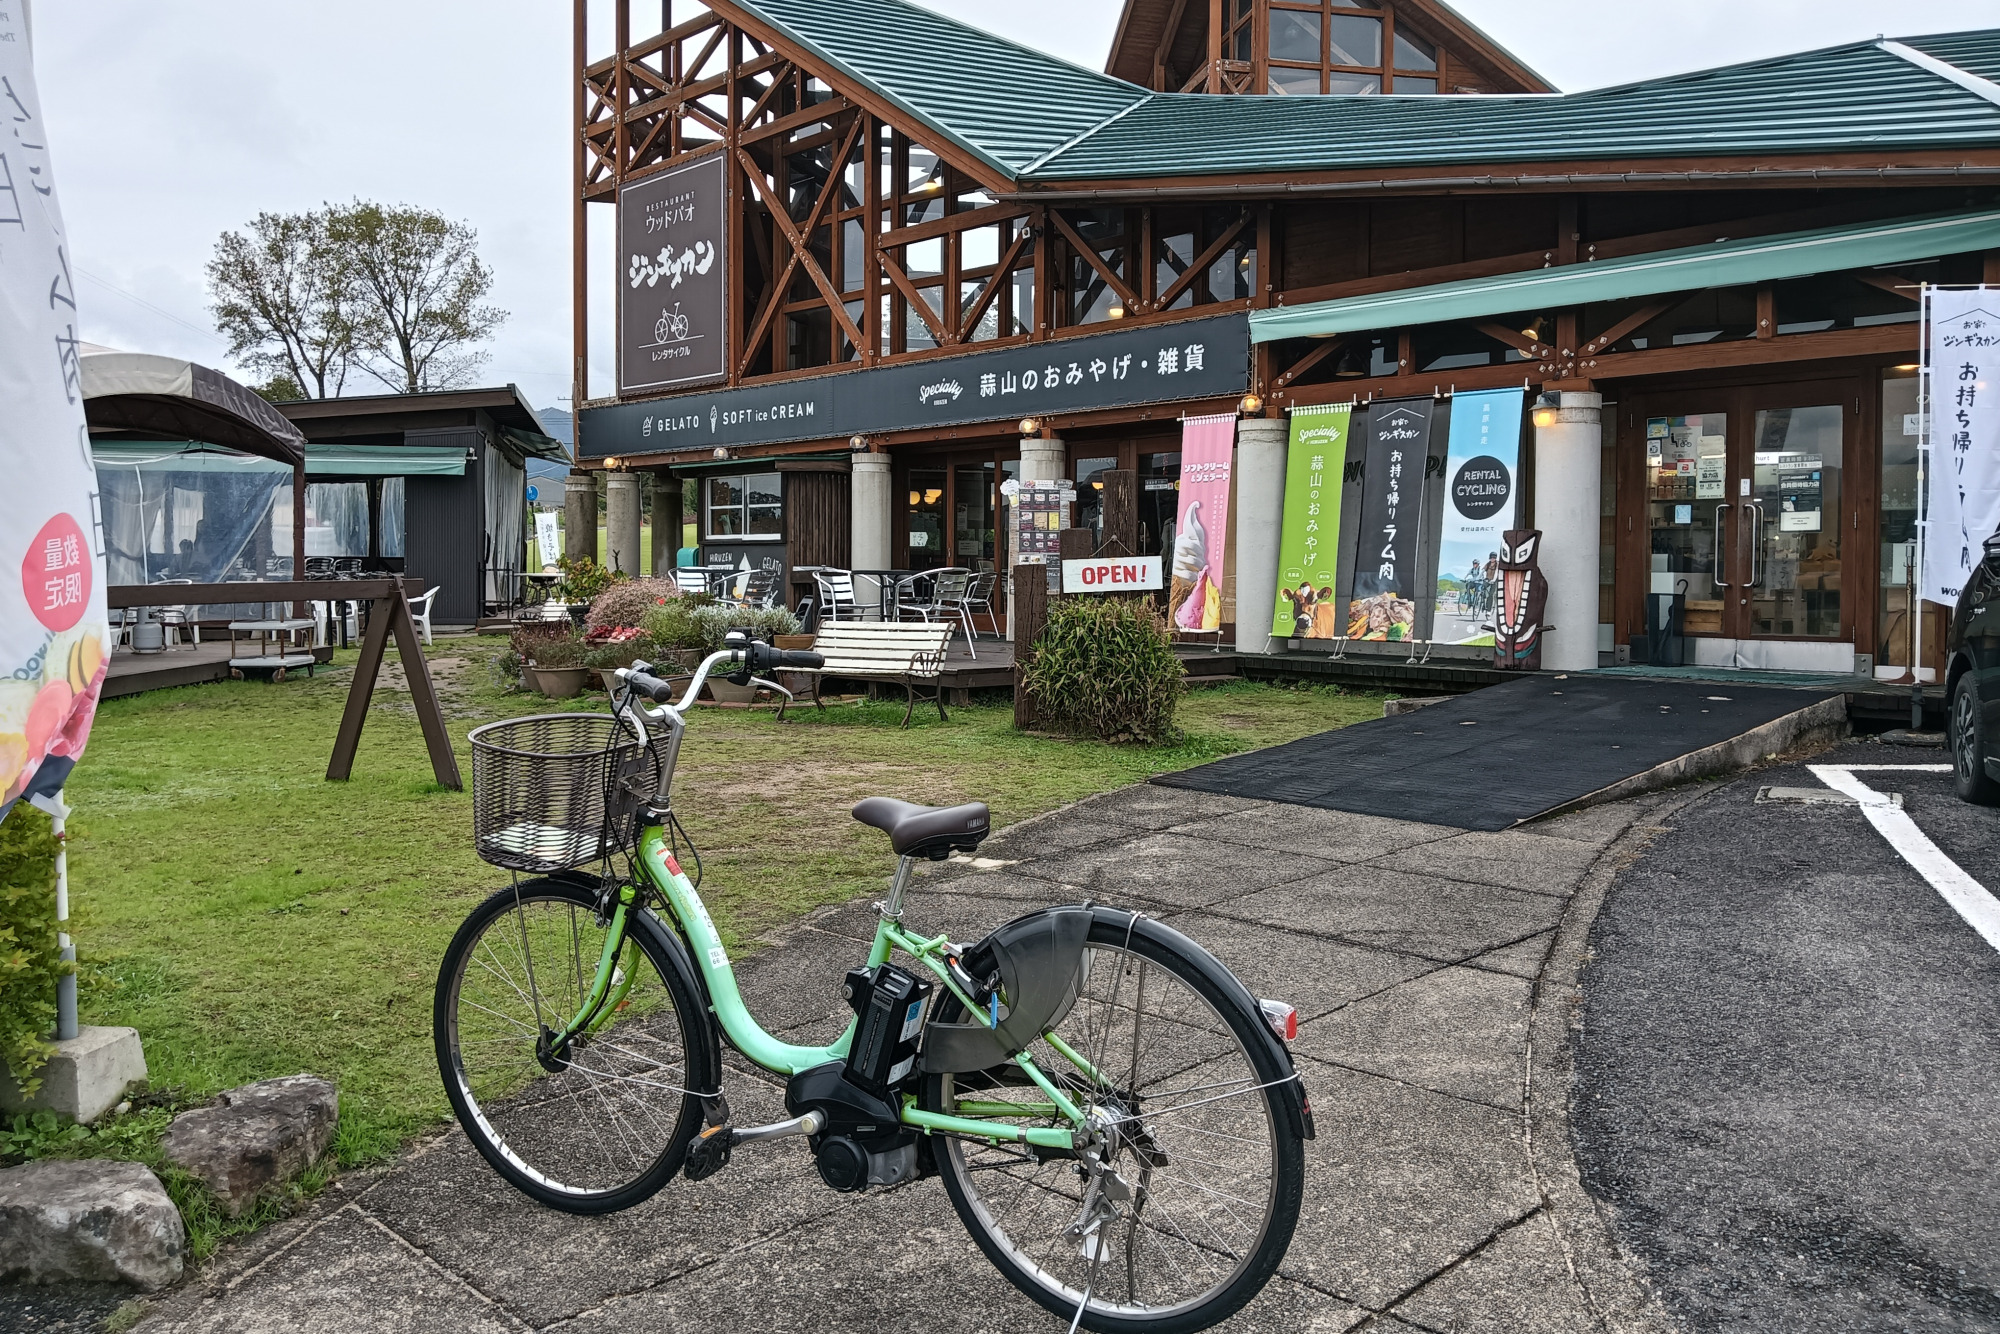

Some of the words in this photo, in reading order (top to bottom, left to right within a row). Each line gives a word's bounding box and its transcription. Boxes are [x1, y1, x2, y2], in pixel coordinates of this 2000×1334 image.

[646, 191, 695, 212] RESTAURANT
[646, 203, 695, 234] ウッドパオ
[629, 240, 715, 289] ジンギスカン
[1943, 333, 2000, 347] ジンギスカン
[652, 346, 690, 361] レンタサイクル
[979, 344, 1205, 398] 蒜山のおみやげ・雑貨
[722, 409, 752, 425] SOFT
[755, 410, 768, 422] ice
[771, 402, 814, 420] CREAM
[657, 415, 700, 432] GELATO
[1379, 428, 1420, 441] ジンギスカン
[1184, 462, 1230, 473] ソフトクリーム
[1464, 470, 1501, 481] RENTAL
[1456, 484, 1507, 496] CYCLING
[1303, 455, 1324, 567] 蒜山のおみやげ
[1081, 564, 1147, 585] OPEN!
